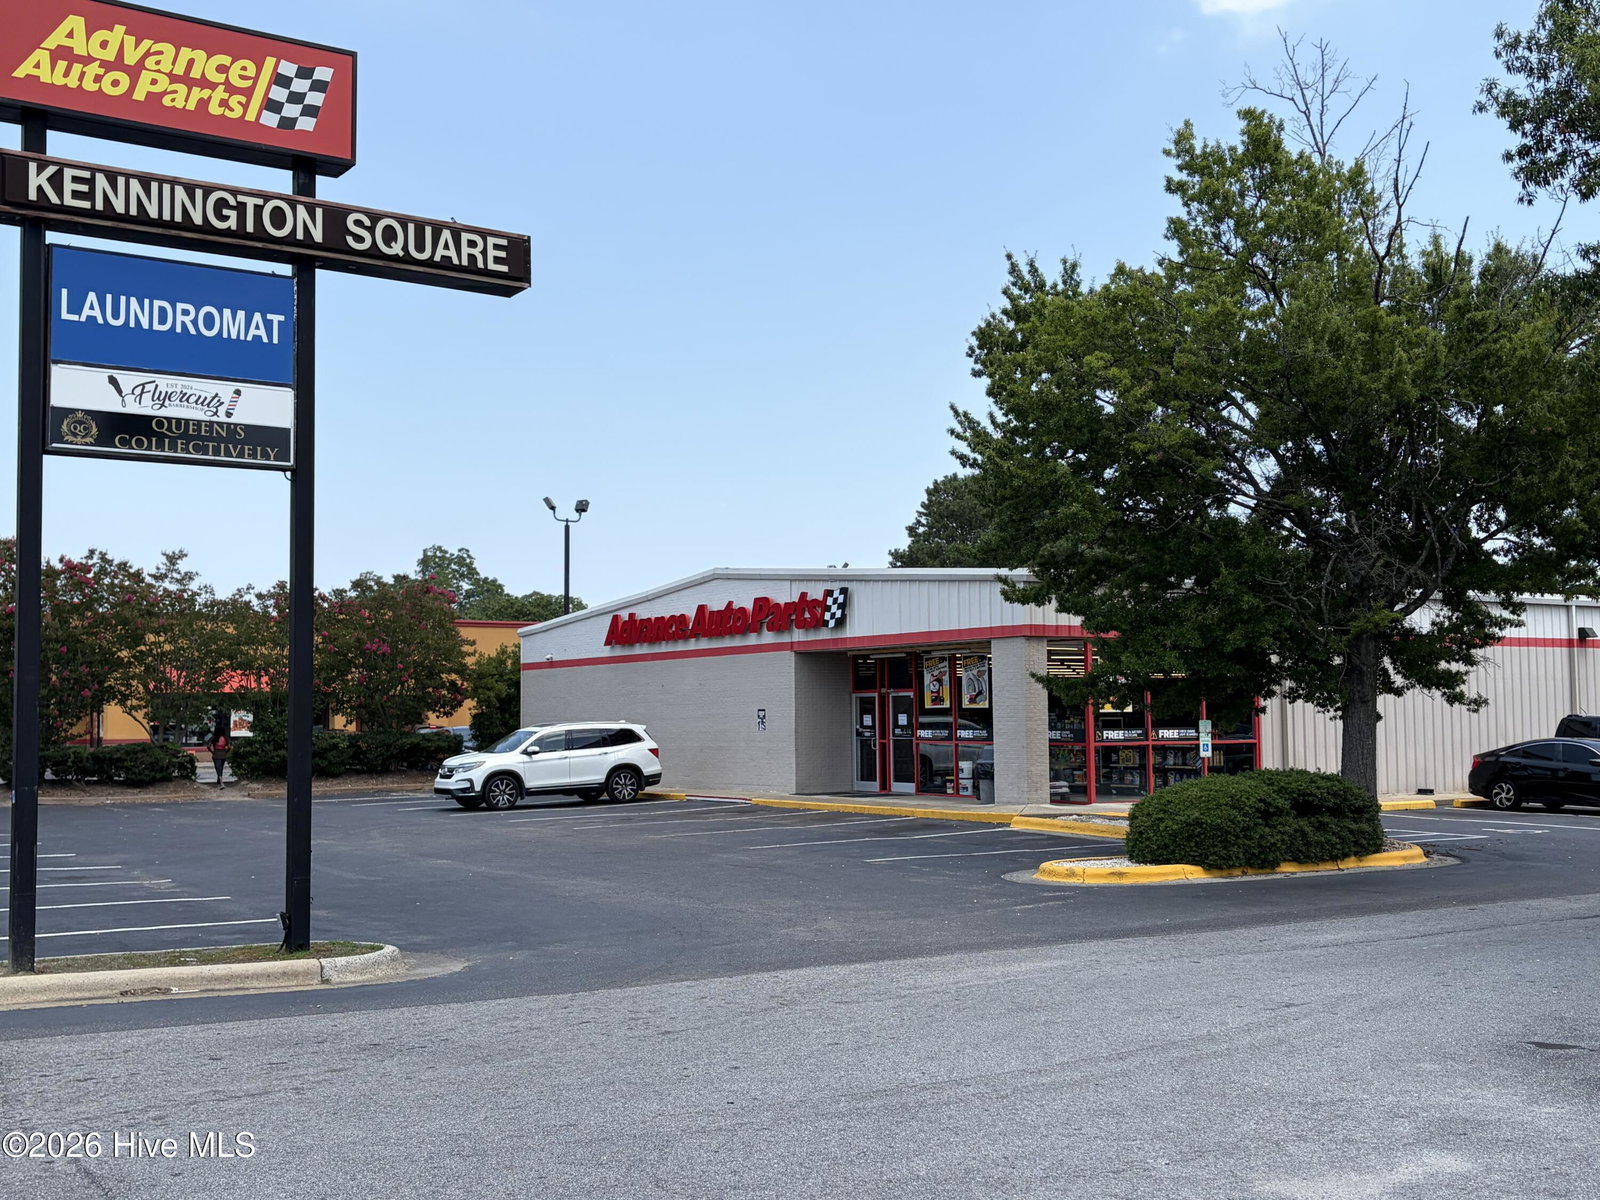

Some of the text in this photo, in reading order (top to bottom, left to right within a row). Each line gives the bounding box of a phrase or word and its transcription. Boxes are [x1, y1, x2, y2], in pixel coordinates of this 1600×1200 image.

[40, 14, 257, 88] Advance
[11, 48, 247, 119] Auto Parts
[27, 161, 510, 273] KENNINGTON SQUARE
[60, 287, 286, 344] LAUNDROMAT
[128, 379, 225, 418] Flyercutz
[168, 402, 205, 412] BARBERSHOP
[70, 423, 90, 436] QC
[152, 417, 245, 439] QUEEN'S
[114, 434, 279, 461] COLLECTIVELY
[604, 592, 821, 646] Advance Auto Parts
[917, 729, 932, 738] FREE
[957, 729, 973, 738] FREE
[1048, 730, 1061, 739] REE
[1103, 730, 1124, 740] FREE
[1159, 729, 1179, 738] FREE
